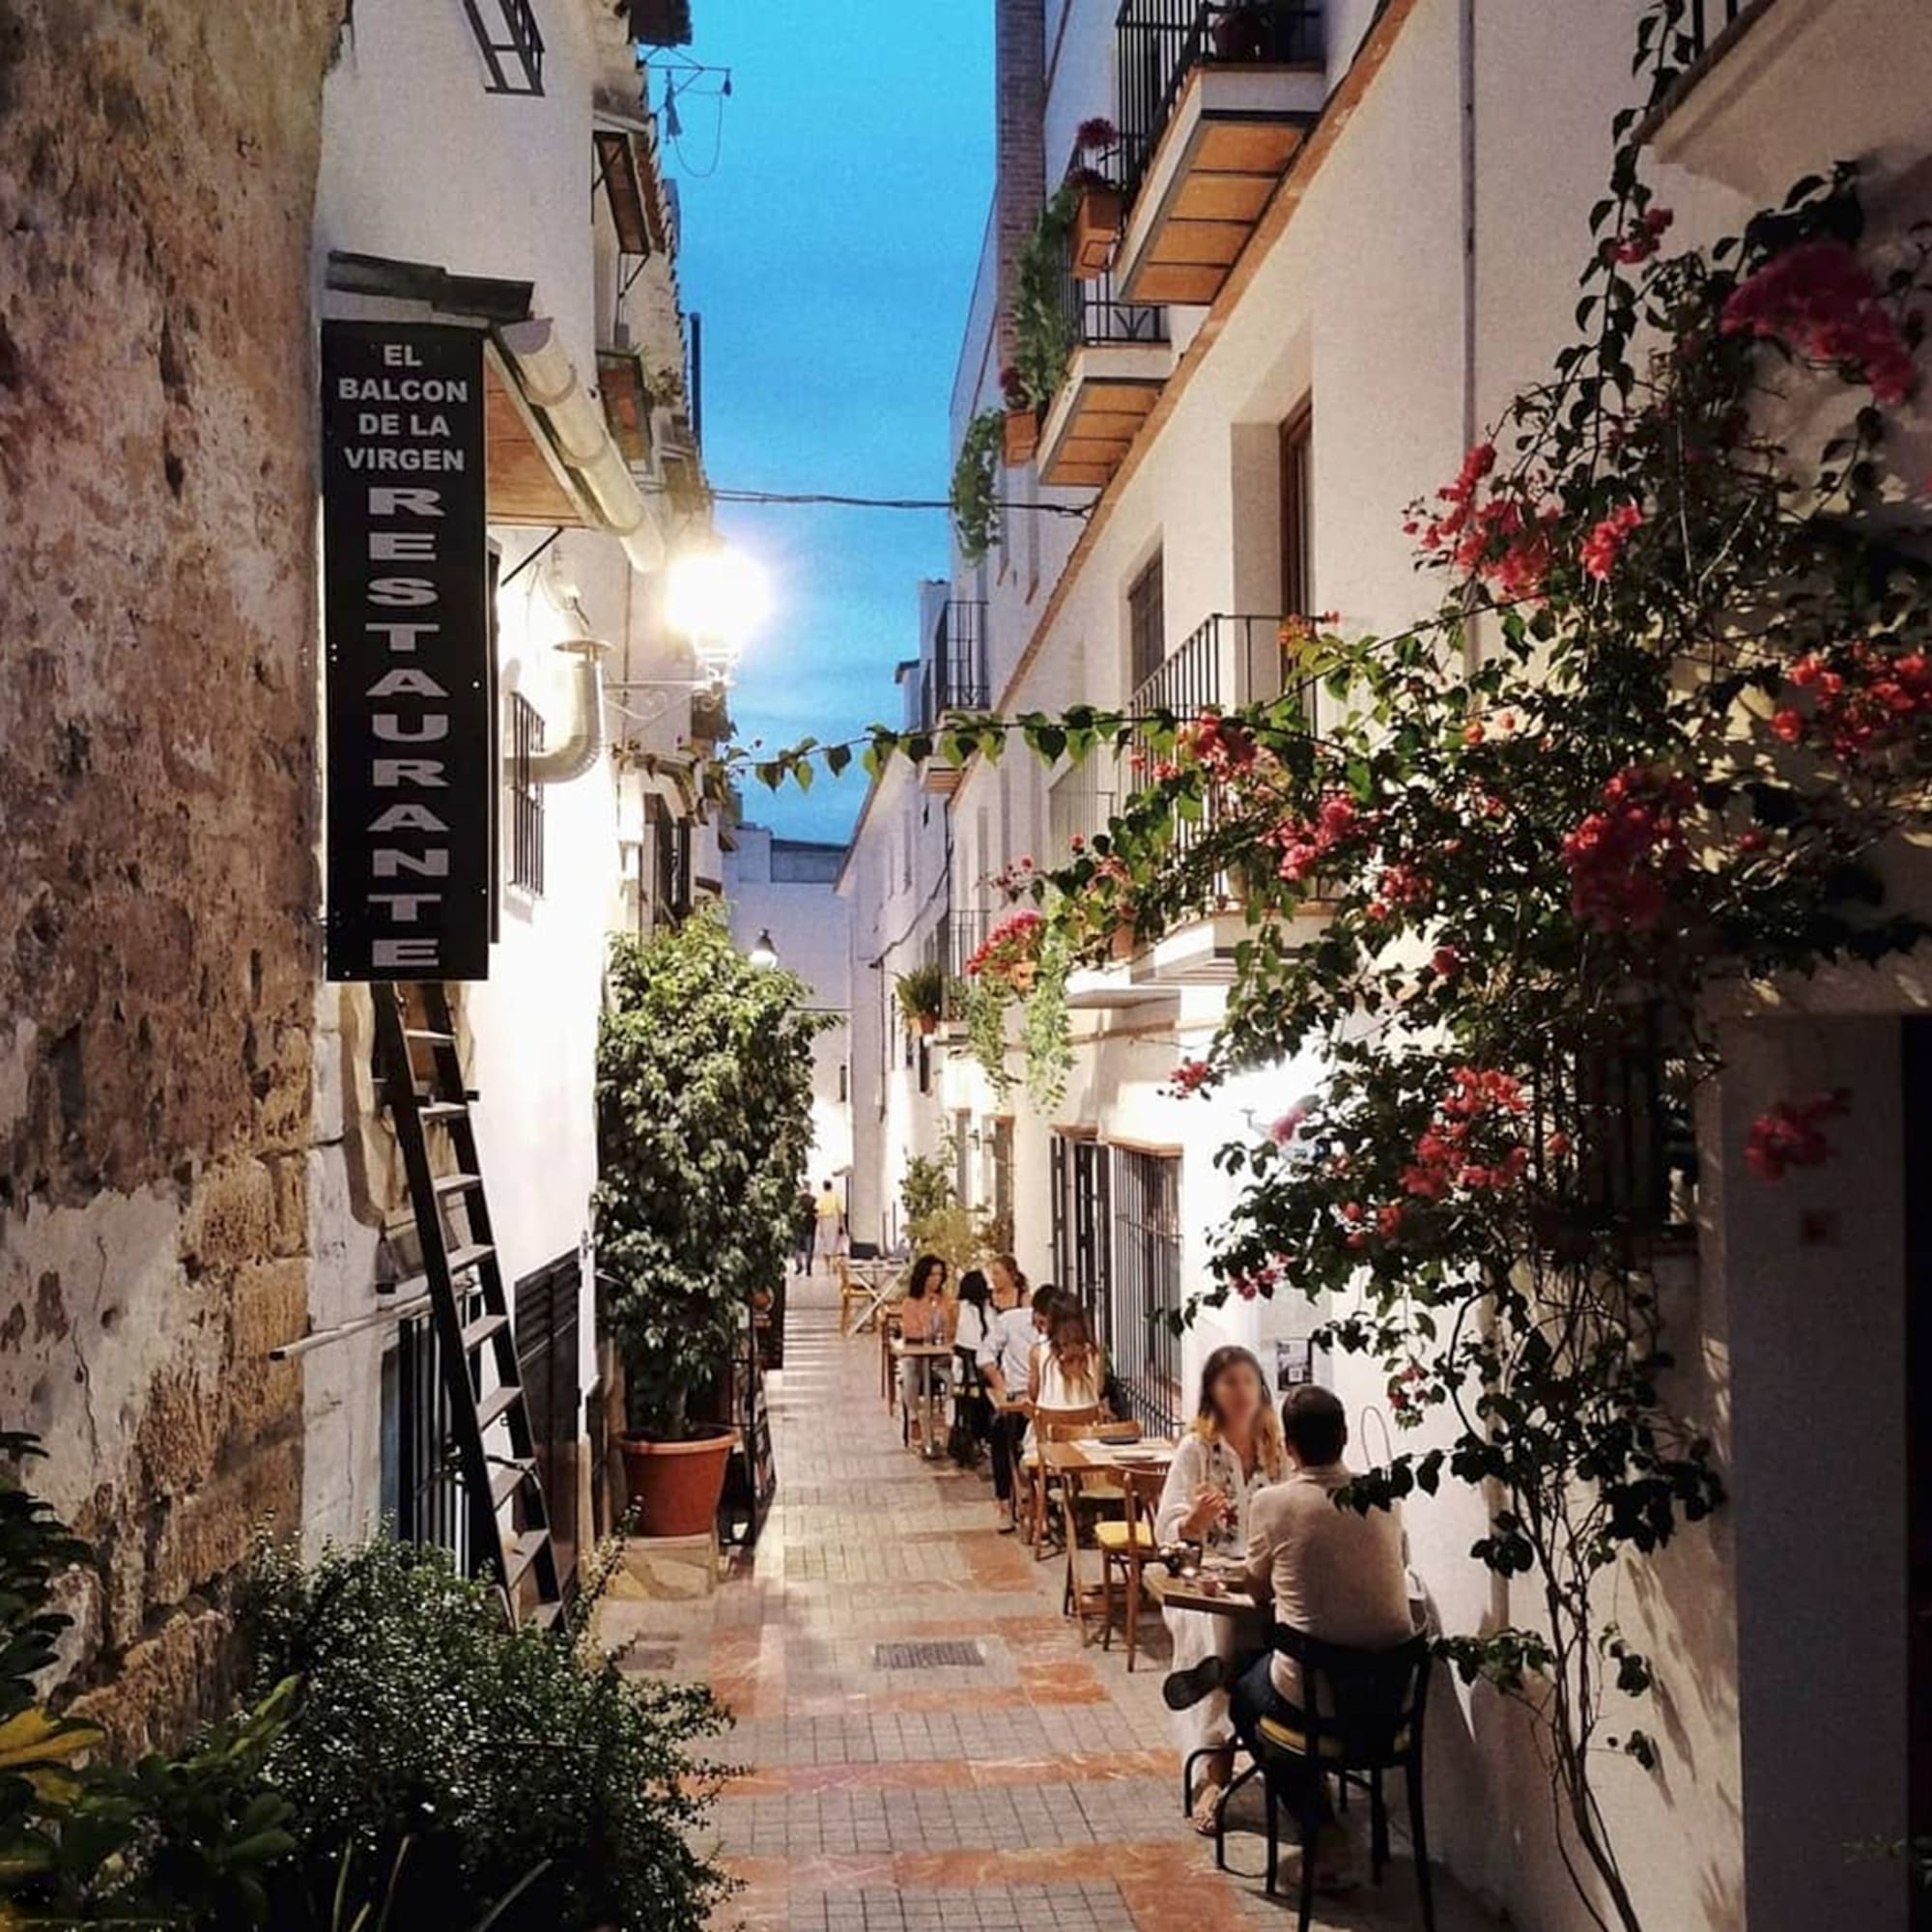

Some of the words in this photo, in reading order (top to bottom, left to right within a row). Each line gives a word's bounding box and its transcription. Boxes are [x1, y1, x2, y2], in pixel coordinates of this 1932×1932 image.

[384, 344, 422, 367] EL
[338, 378, 468, 404] BALCON
[358, 413, 399, 437] DE
[411, 413, 450, 437] LA
[344, 448, 465, 471] VIRGEN
[365, 487, 450, 968] RESTAURANTE
